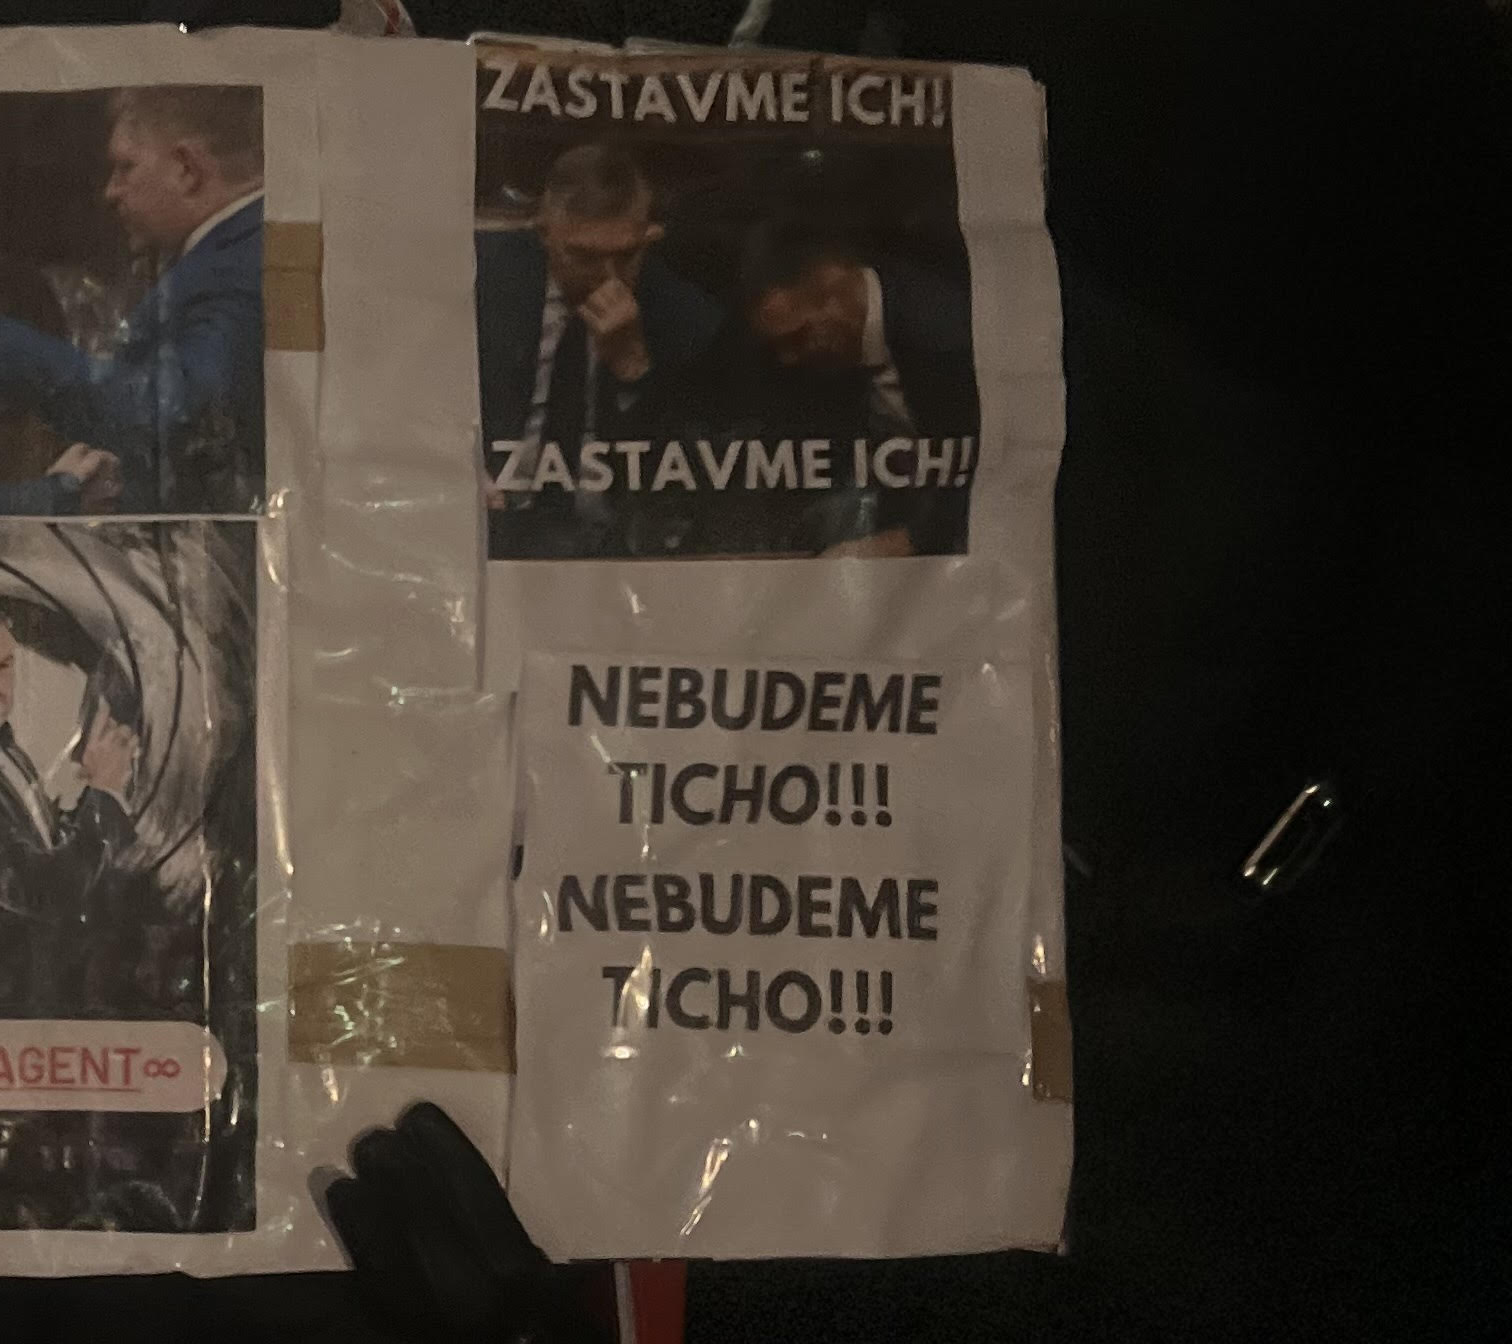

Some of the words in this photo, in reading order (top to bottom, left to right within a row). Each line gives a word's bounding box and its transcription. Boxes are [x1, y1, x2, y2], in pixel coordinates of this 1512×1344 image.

[480, 60, 809, 124] ZASTAVME
[831, 71, 947, 129] ICH!
[491, 438, 833, 494] ZASTAVME
[853, 436, 975, 489] ICH!
[567, 664, 943, 735] NEBUDEME
[605, 762, 894, 828] TICHO!!!
[557, 872, 939, 942] NEBUDEME
[602, 967, 894, 1037] TICHO!!!
